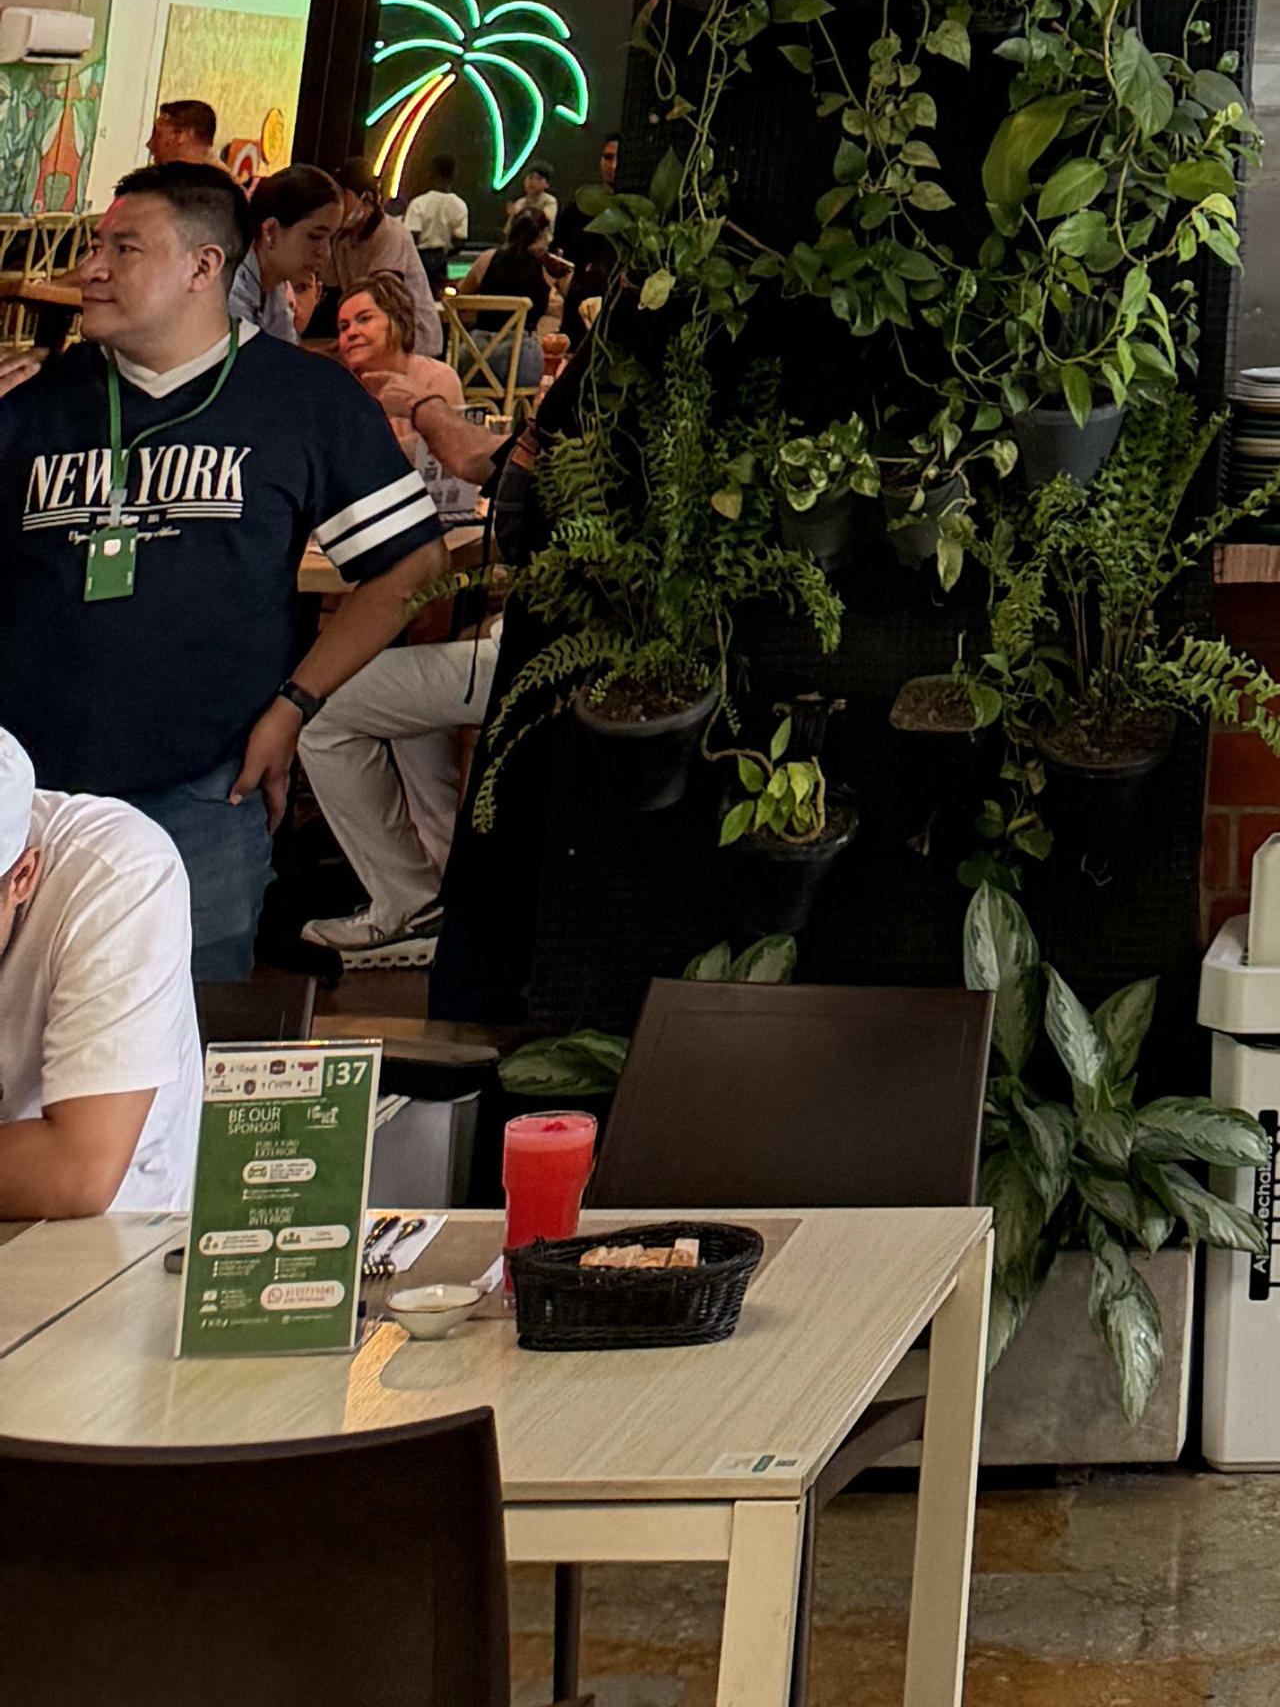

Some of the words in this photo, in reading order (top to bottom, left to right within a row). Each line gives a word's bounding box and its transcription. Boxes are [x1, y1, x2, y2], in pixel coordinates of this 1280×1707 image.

[24, 448, 129, 514] NEW
[134, 444, 252, 505] YORK
[335, 1061, 368, 1086] 37
[228, 1107, 247, 1124] BE
[249, 1106, 281, 1122] OUR
[228, 1122, 281, 1136] SPONSOR
